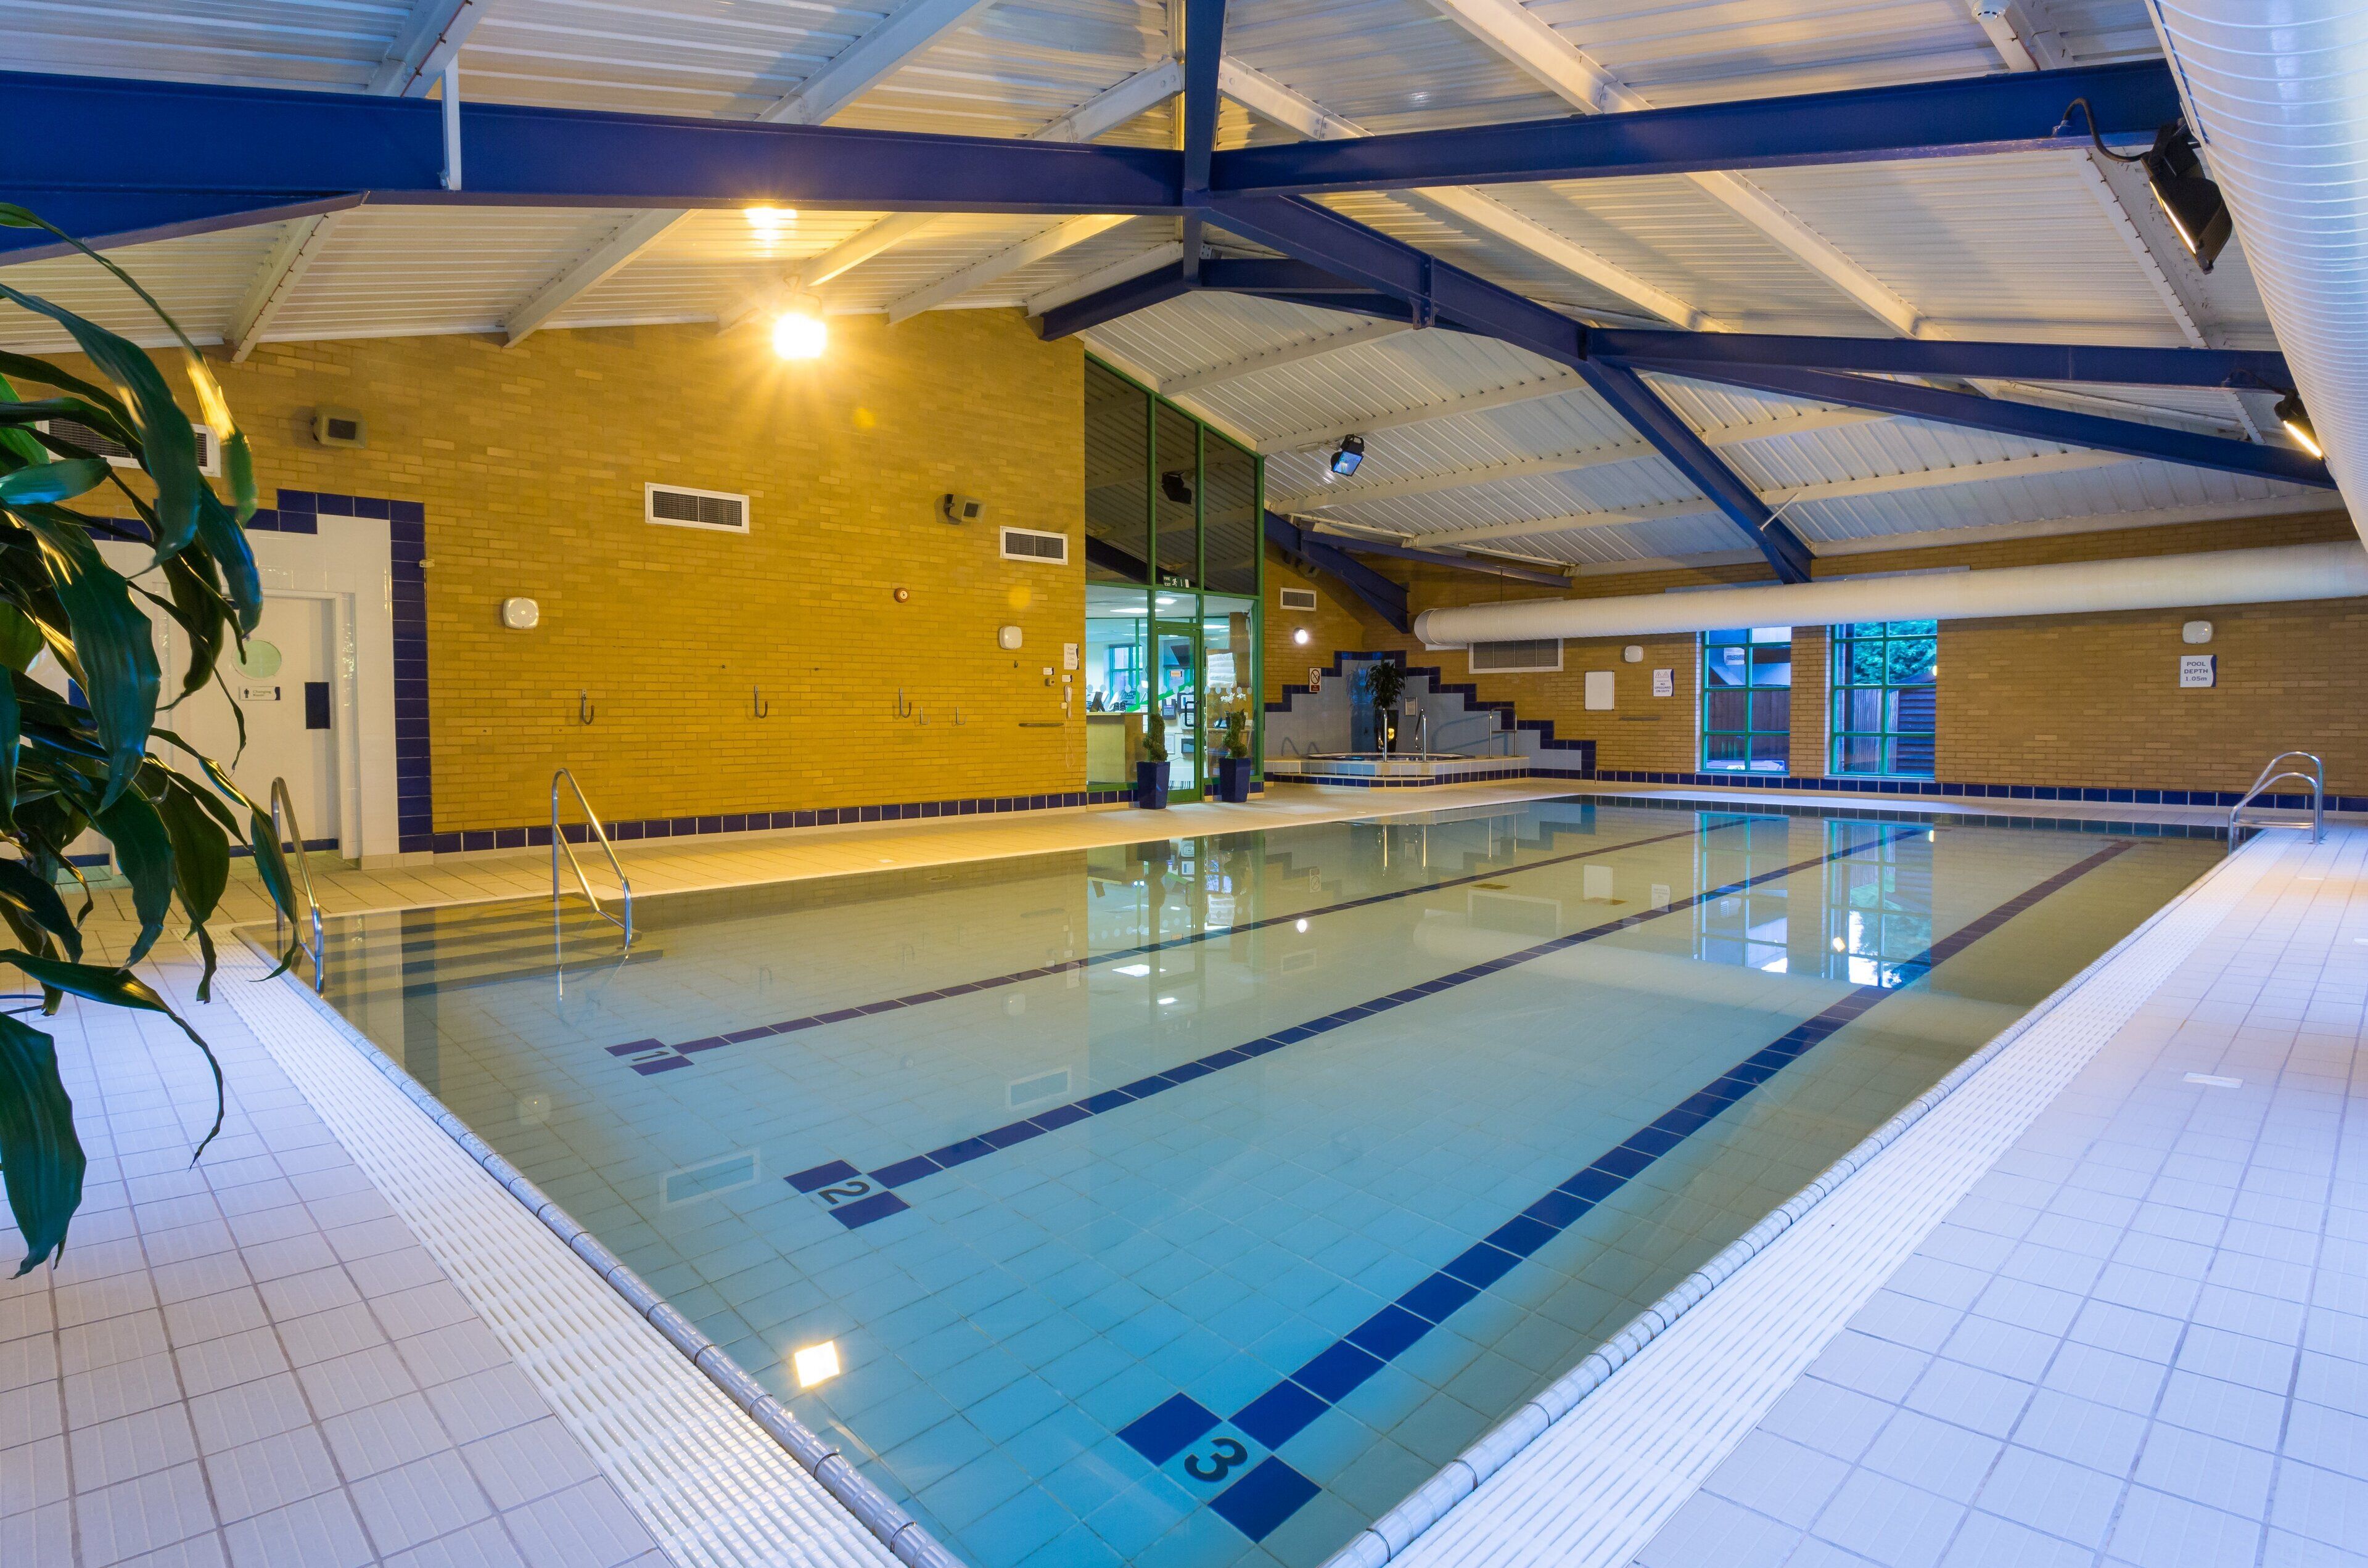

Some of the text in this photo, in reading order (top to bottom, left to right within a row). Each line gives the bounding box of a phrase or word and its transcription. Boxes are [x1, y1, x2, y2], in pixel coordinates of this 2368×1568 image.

[631, 1051, 670, 1062] 1
[818, 1181, 870, 1205] 2
[1184, 1437, 1248, 1482] 3
